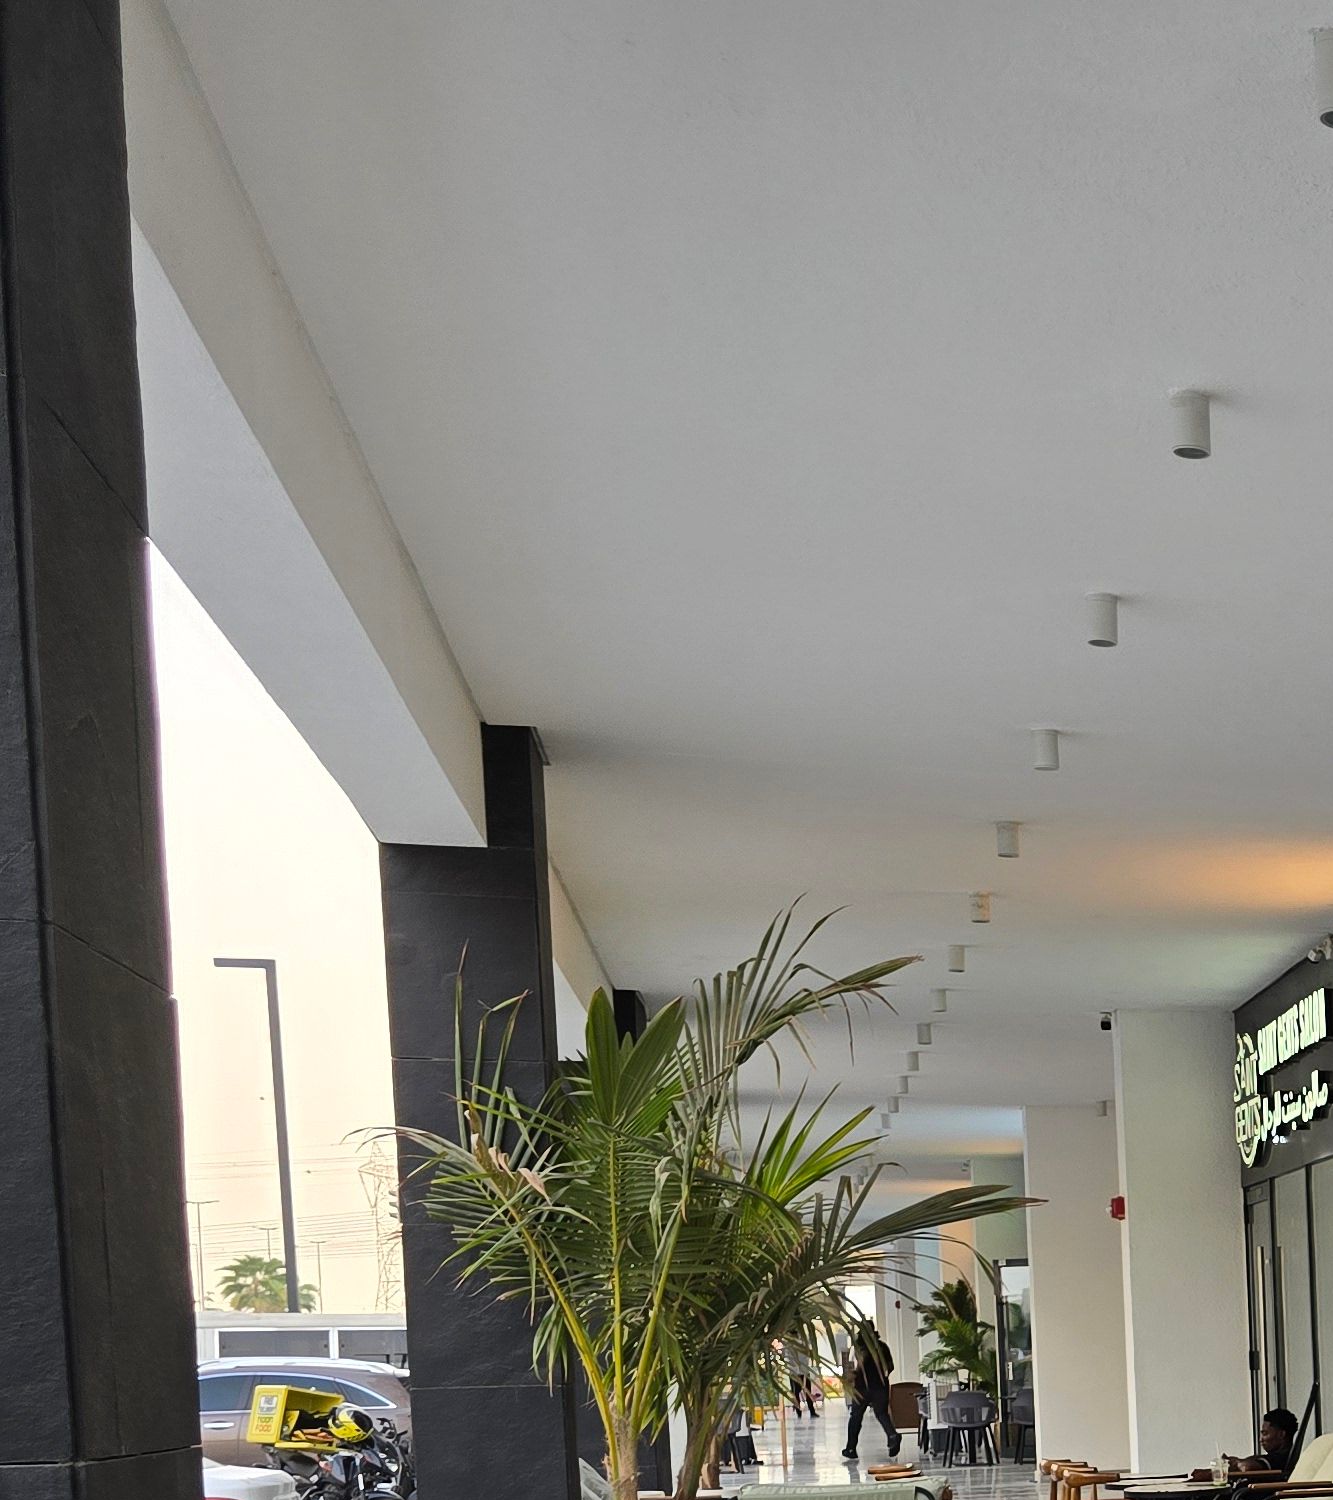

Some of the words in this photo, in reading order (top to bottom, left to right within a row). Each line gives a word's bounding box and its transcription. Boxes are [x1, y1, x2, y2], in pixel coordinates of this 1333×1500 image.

[1299, 987, 1326, 1050] SALON
[1234, 1049, 1258, 1103] SAINT
[1235, 1094, 1261, 1144] GENTS
